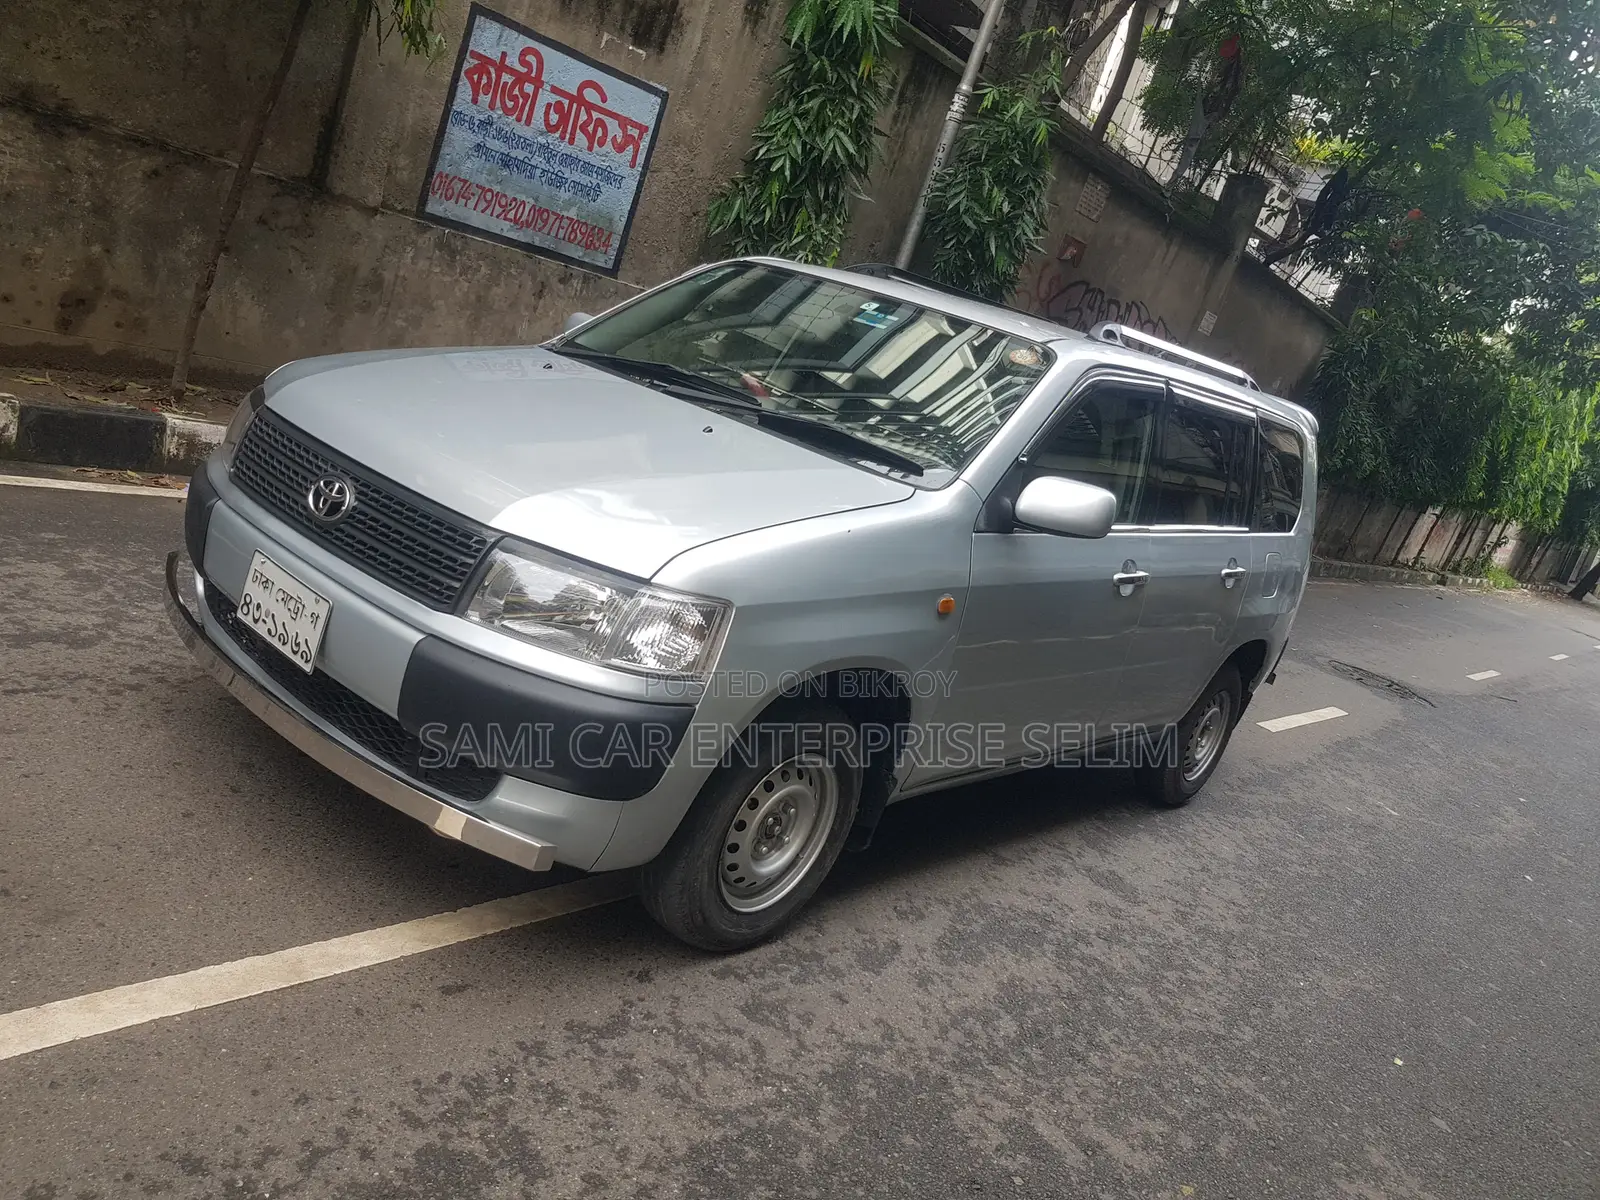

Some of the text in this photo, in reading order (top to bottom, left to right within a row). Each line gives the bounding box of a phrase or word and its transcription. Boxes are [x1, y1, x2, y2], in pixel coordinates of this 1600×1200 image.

[464, 46, 649, 168] কাজী অফিস
[252, 568, 275, 596] ঢাকা
